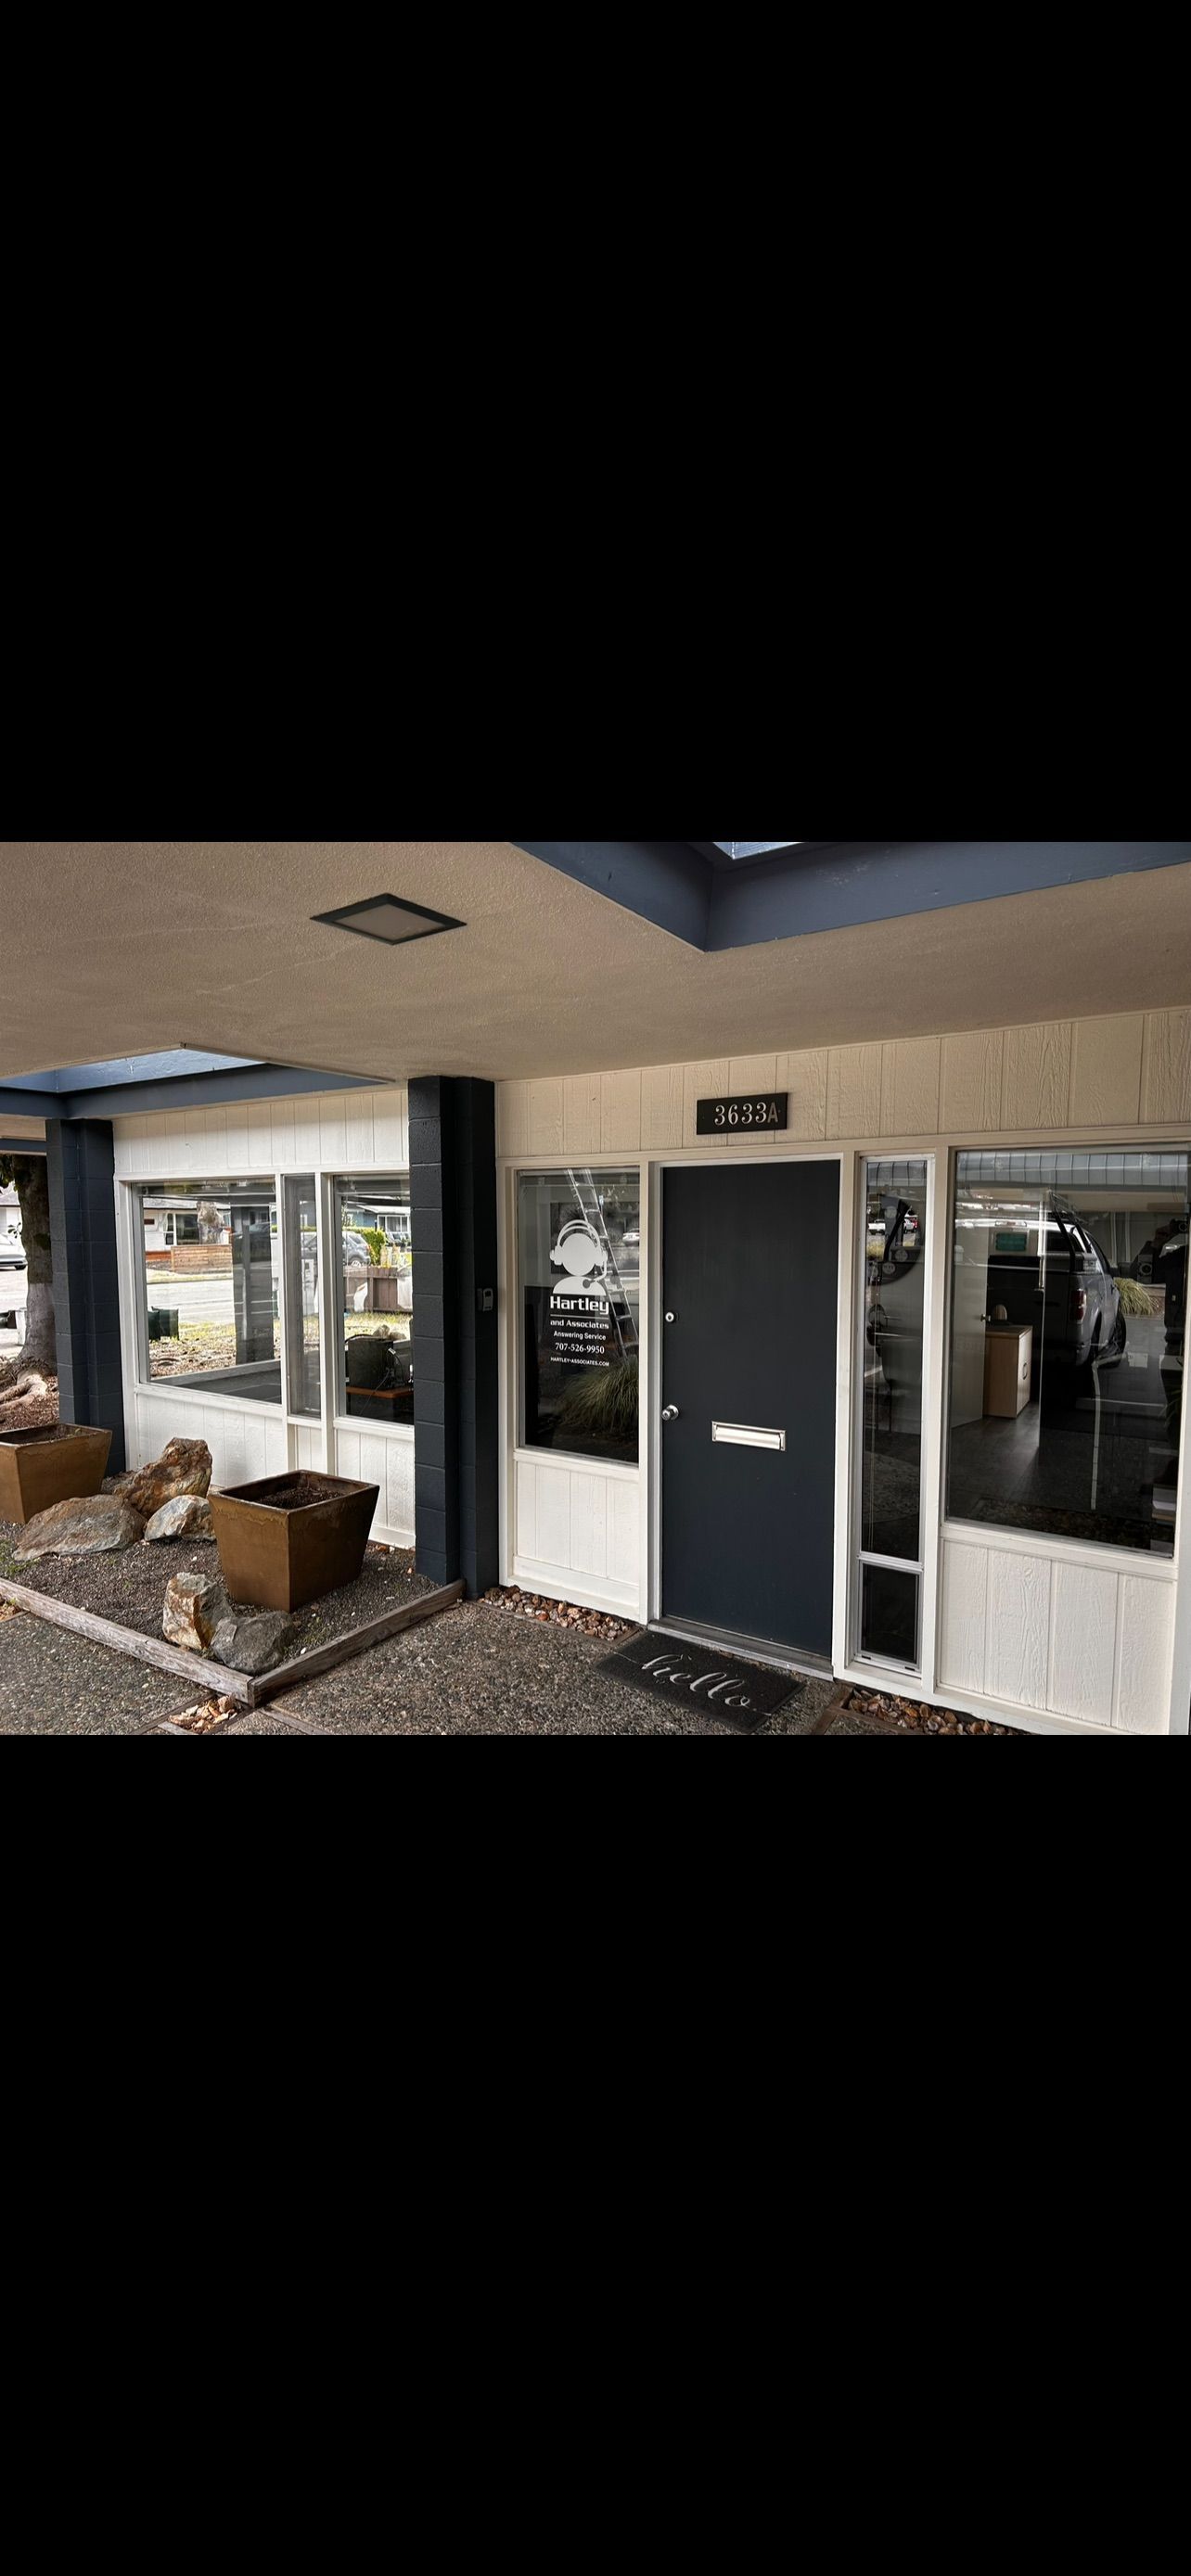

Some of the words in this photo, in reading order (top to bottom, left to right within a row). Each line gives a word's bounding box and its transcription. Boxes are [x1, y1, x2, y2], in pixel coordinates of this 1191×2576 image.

[714, 1102, 778, 1126] 3633A
[550, 1295, 609, 1315] Hartley
[566, 1320, 609, 1329] Associates
[554, 1331, 583, 1340] Answering
[556, 1343, 605, 1354] 707-526-9950
[550, 1357, 609, 1366] HARTLEY-ASSOCIATES.COM
[642, 1653, 752, 1709] hello
